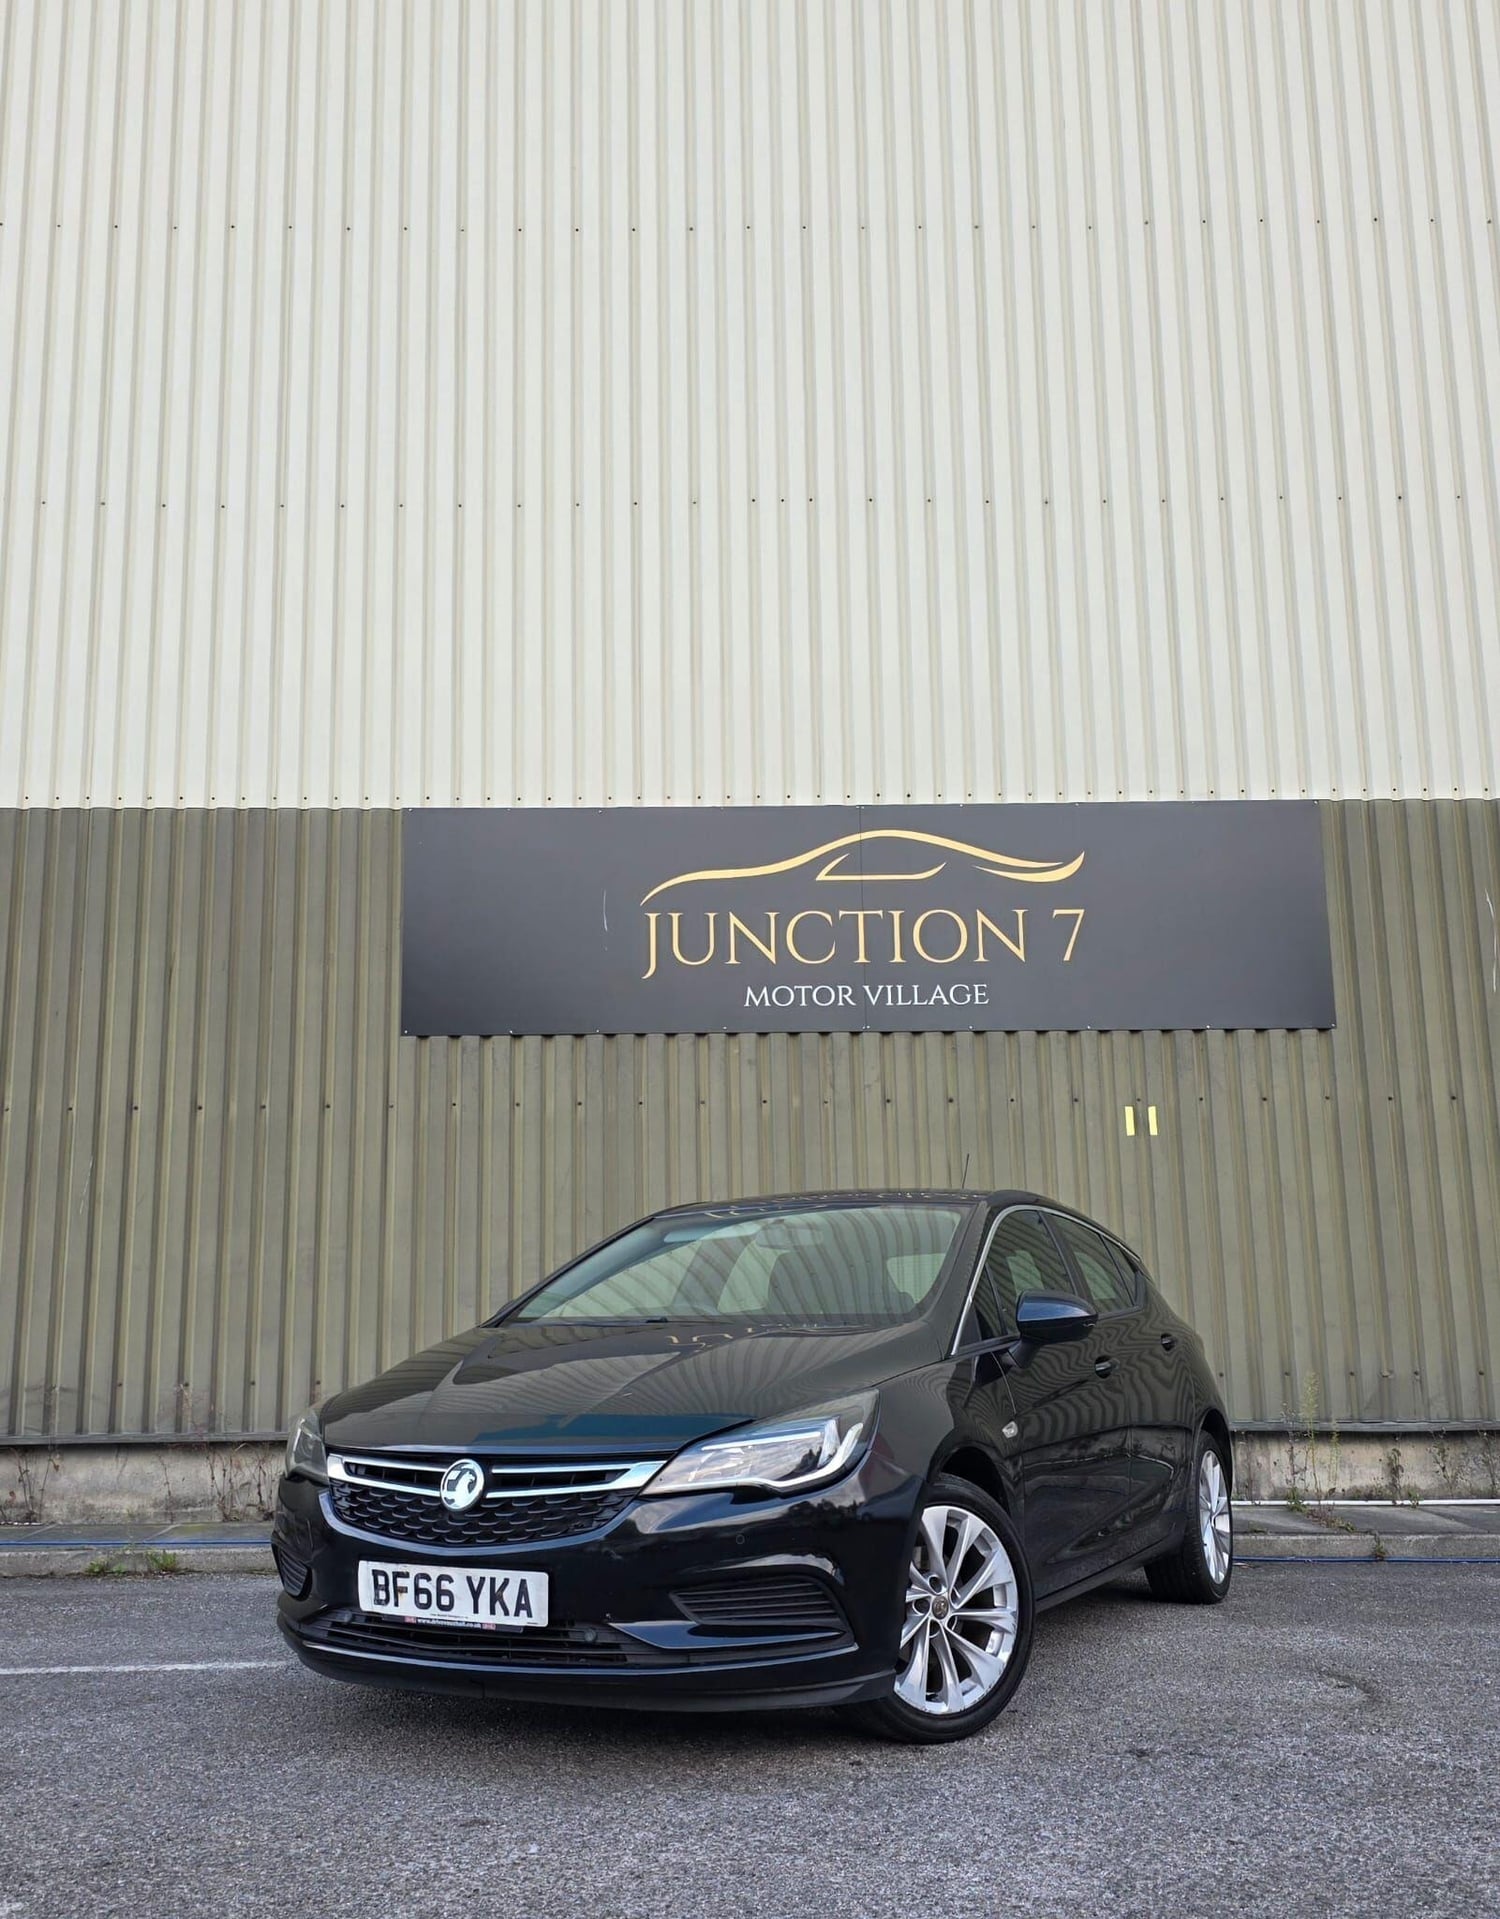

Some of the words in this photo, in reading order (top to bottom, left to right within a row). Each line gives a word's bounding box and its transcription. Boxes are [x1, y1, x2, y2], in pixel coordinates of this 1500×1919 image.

[641, 908, 1029, 980] JUNCTION
[1051, 908, 1086, 962] 7
[743, 985, 857, 1007] MOTOR
[862, 983, 990, 1006] VILLAGE
[371, 1568, 455, 1612] BF66
[465, 1575, 533, 1618] YKA
